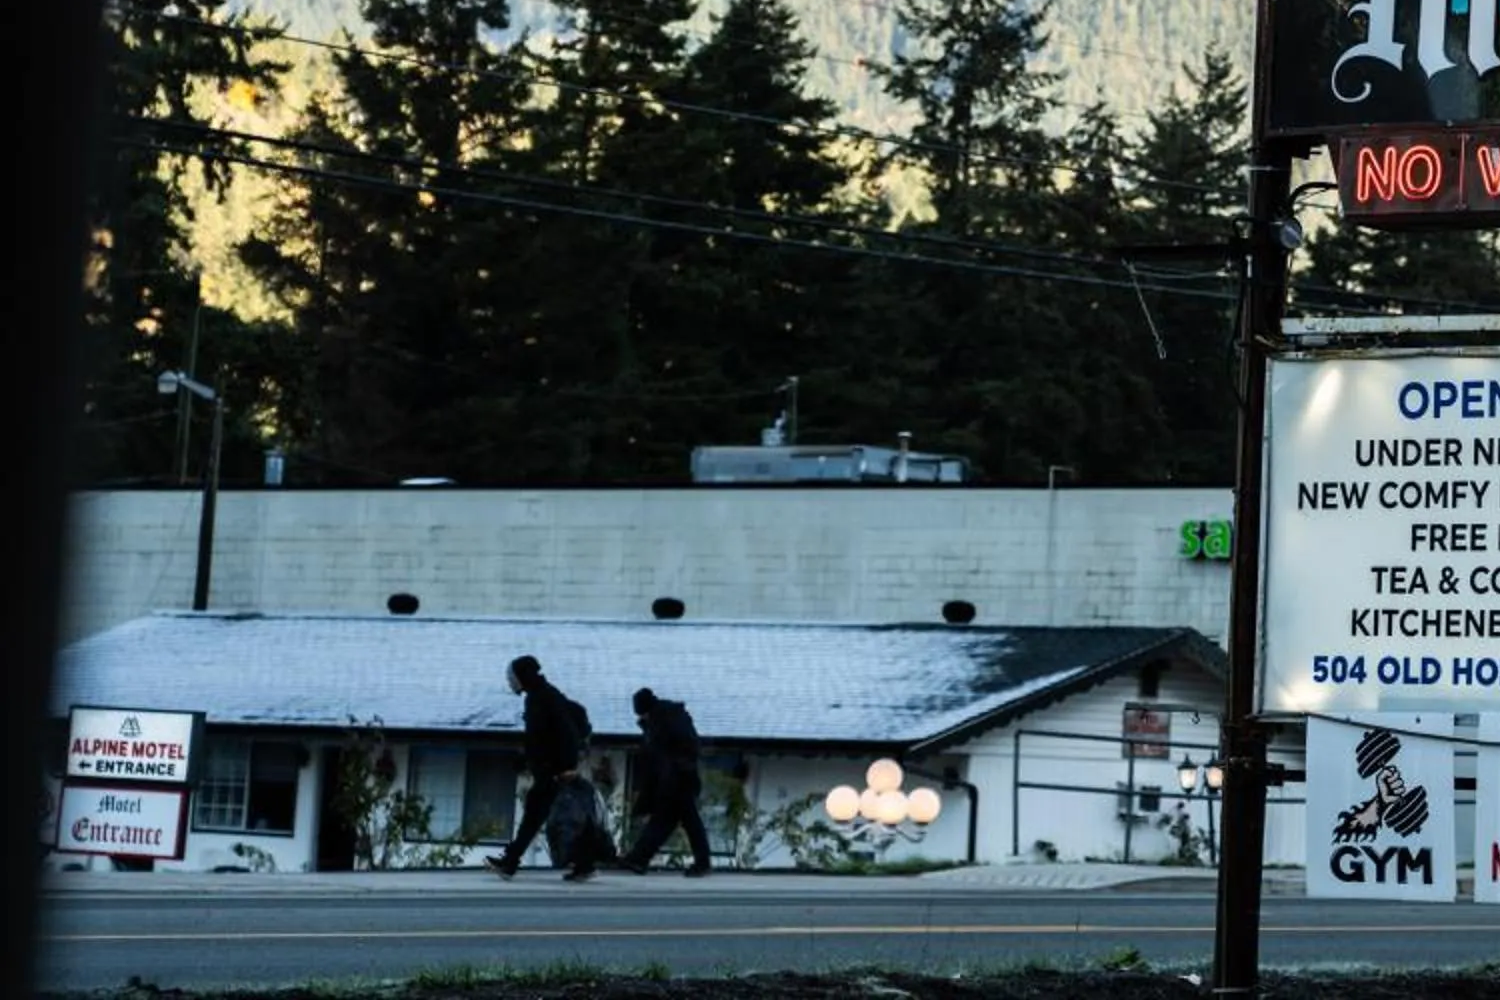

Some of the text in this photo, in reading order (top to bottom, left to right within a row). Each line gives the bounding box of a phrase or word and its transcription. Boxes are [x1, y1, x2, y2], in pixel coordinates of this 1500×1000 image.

[1356, 144, 1442, 202] NO
[1355, 439, 1464, 467] UNDER
[1298, 482, 1370, 511] NEW
[1379, 480, 1490, 510] COMFY
[1411, 524, 1487, 552] FREE
[1371, 567, 1429, 594] TEA
[1438, 567, 1460, 595] &
[1312, 655, 1367, 684] 504
[1377, 656, 1441, 685] OLD
[71, 738, 185, 760] ALPINE MOTEL
[95, 760, 176, 776] ENTRANCE
[97, 795, 142, 814] Motel
[72, 817, 163, 847] Entrance
[1329, 846, 1433, 885] GYM
